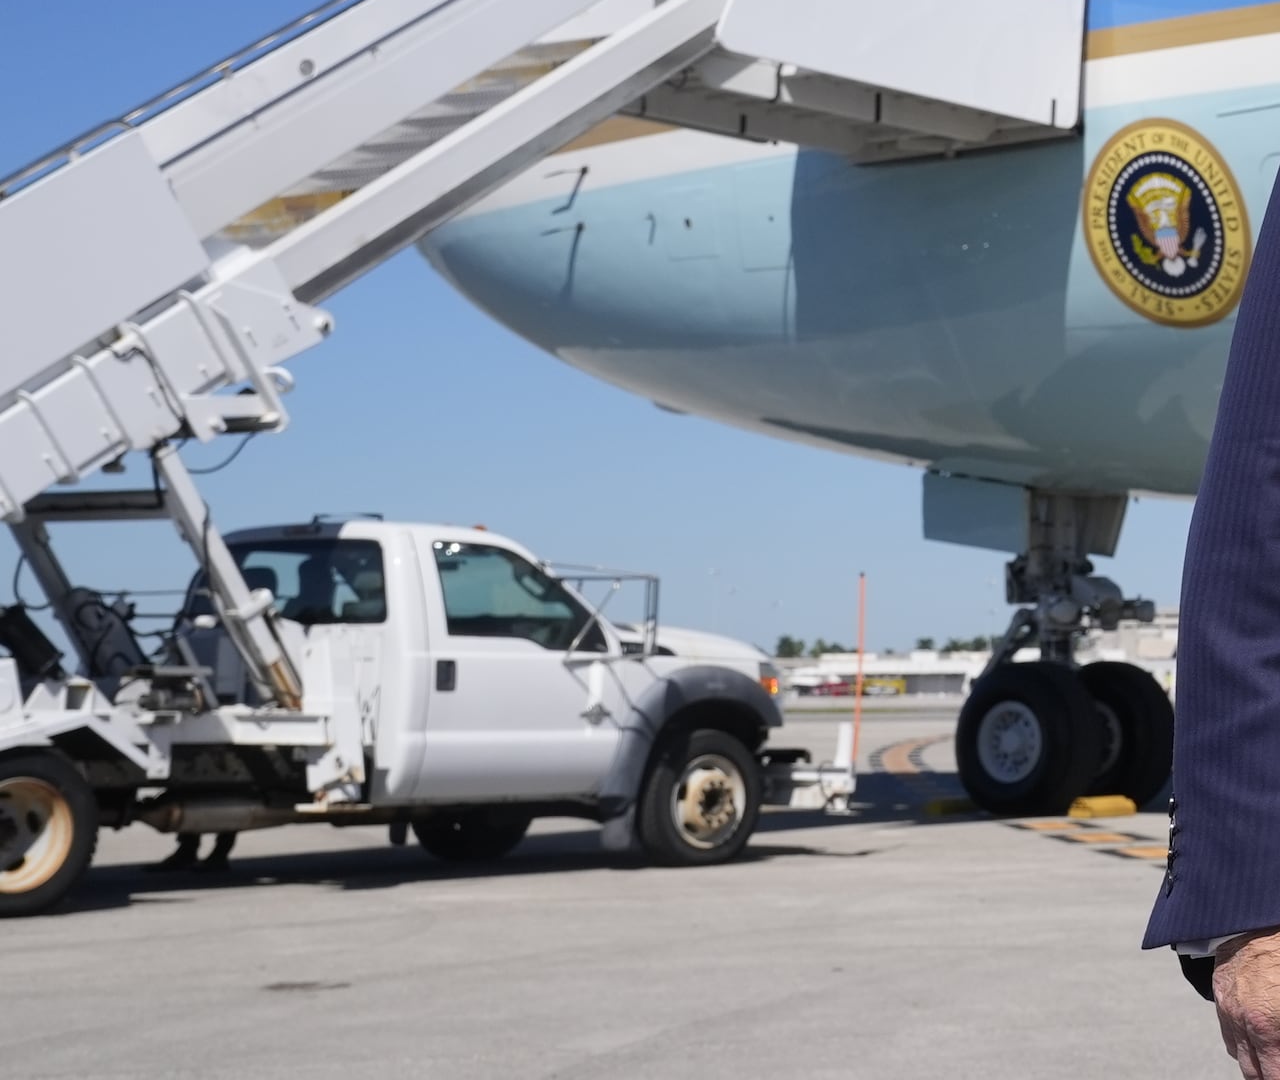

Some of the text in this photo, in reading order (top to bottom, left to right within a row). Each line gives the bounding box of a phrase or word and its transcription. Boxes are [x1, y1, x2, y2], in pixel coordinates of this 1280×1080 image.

[1152, 132, 1165, 145] OF
[1169, 134, 1190, 153] THE
[1092, 132, 1146, 230] PRESIDENT
[1195, 150, 1239, 233] UNITED
[1129, 284, 1177, 316] SEAL
[1205, 247, 1242, 311] STATES
